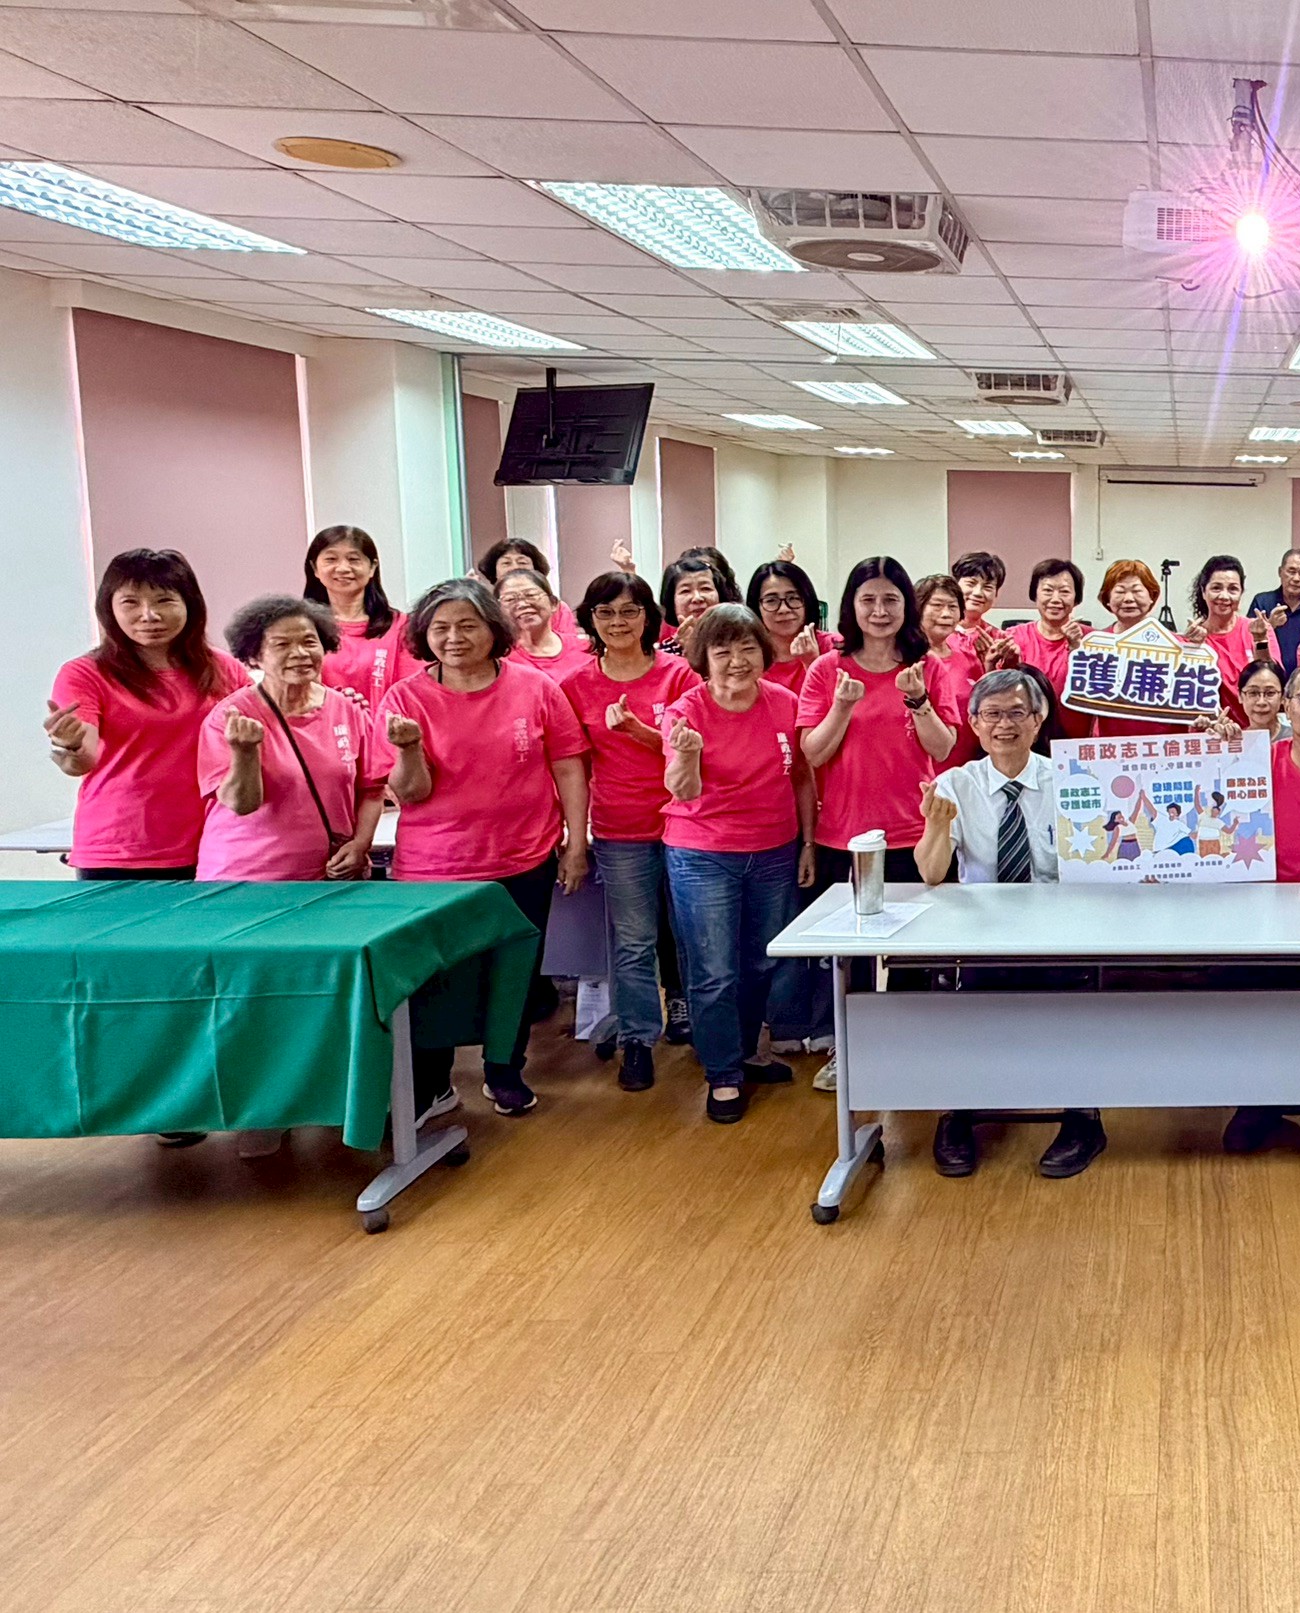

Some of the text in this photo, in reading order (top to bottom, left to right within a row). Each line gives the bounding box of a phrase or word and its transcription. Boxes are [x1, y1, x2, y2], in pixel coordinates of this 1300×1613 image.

[1070, 651, 1219, 708] 護廉能
[776, 732, 793, 775] 廉政志工
[1078, 736, 1243, 761] 廉政志工倫理宣言
